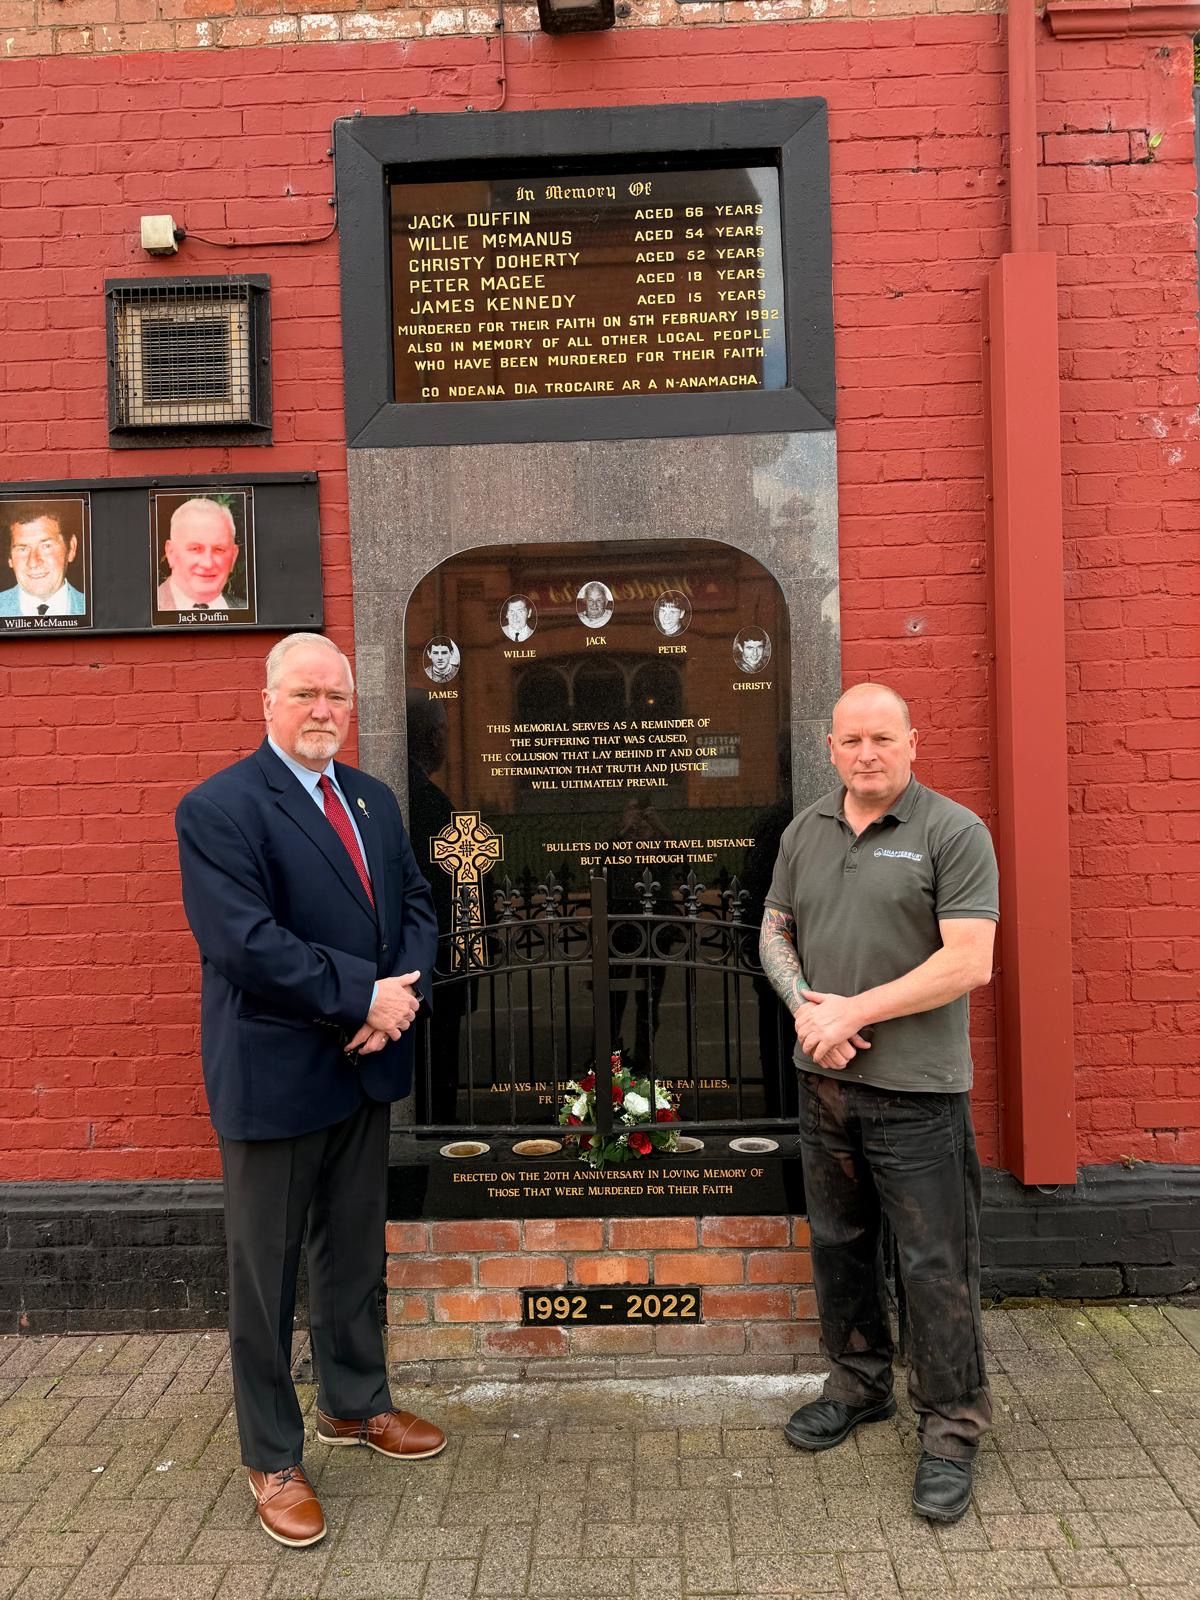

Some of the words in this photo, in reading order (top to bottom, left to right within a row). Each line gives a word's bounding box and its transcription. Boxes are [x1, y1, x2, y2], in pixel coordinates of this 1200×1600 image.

[517, 186, 535, 201] In
[545, 184, 616, 200] Memory
[628, 181, 652, 196] Of
[408, 214, 455, 230] JACK
[467, 211, 531, 227] DUFFIN
[634, 208, 674, 220] AGED
[685, 207, 704, 217] 66
[715, 204, 764, 216] YEARS
[408, 235, 469, 252] WILLIE
[634, 229, 674, 242] AGED
[685, 228, 705, 239] 54
[715, 225, 765, 238] YEARS
[409, 256, 485, 273] CHRISTY
[496, 252, 580, 270] DOHERTY
[635, 251, 675, 263] AGED
[686, 250, 706, 261] 52
[716, 247, 766, 260] YEARS
[409, 278, 470, 294] PETER
[481, 274, 546, 291] MAGEE
[635, 272, 675, 284] AGED
[687, 271, 703, 282] 18
[716, 268, 766, 281] YEARS
[410, 298, 475, 315] JAMES
[487, 294, 576, 312] KENNEDY
[636, 293, 676, 305] AGED
[688, 292, 702, 303] 15
[717, 289, 766, 301] YEARS
[398, 323, 471, 336] MURDERED
[478, 321, 505, 333] FOR
[510, 319, 550, 332] THEIR
[556, 317, 596, 330] FAITH
[603, 315, 621, 328] ON
[629, 314, 654, 327] 5TH
[662, 310, 738, 325] FEBRUARY
[407, 342, 442, 354] ALSO
[450, 341, 464, 352] IN
[472, 338, 533, 351] MEMORY
[542, 337, 560, 349] OF
[567, 336, 593, 348] ALL
[601, 334, 648, 346] OTHER
[657, 331, 705, 345] LOCAL
[713, 328, 772, 342] PEOPLE
[414, 360, 446, 371] WHO
[454, 358, 492, 370] HAVE
[500, 356, 539, 369] BEEN
[548, 353, 628, 367] MURDERED
[636, 351, 665, 363] FOR
[672, 349, 716, 361] THEIR
[723, 347, 768, 359] FAITH.
[421, 387, 440, 398] GO
[449, 385, 505, 397] NDEANA
[514, 383, 538, 395] DIA
[544, 380, 615, 393] TROCAIRE
[622, 379, 641, 390] AR
[648, 378, 658, 389] A
[665, 374, 762, 388] N-ANAMACHA.
[5, 618, 32, 628] Willie
[34, 617, 78, 628] McManus
[178, 612, 198, 624] Jack
[200, 611, 229, 621] Duffin
[586, 636, 607, 646] JACK
[503, 650, 537, 659] WILLIE
[658, 645, 687, 654] PETER
[732, 681, 772, 691] CHRISTY
[428, 690, 459, 700] JAMES
[487, 724, 511, 733] THIS
[514, 723, 569, 732] MEMORIAL
[572, 721, 610, 731] SERVES
[613, 721, 627, 730] AS
[630, 720, 638, 729] A
[641, 719, 695, 729] REMINDER
[697, 718, 711, 727] OF
[510, 738, 531, 747] THE
[534, 737, 590, 747] SUFFERING
[592, 736, 620, 745] THAT
[623, 735, 646, 744] WAS
[648, 734, 688, 744] CAUSED,
[481, 753, 502, 762] THE
[505, 751, 559, 761] COLLUSION
[561, 751, 590, 760] THAT
[592, 750, 612, 759] LAY
[615, 749, 654, 759] BEHIND
[656, 748, 667, 758] IT
[669, 748, 693, 757] AND
[695, 747, 718, 756] OUR
[491, 765, 573, 776] DETERMINATION
[575, 765, 604, 774] THAT
[606, 764, 641, 773] TRUTH
[644, 763, 668, 772] AND
[670, 762, 709, 774] JUSTICE
[531, 781, 558, 790] WILL
[560, 779, 624, 789] ULTIMATELY
[541, 843, 592, 852] "BULLETS
[594, 841, 610, 851] DO
[612, 841, 634, 850] NOT
[635, 840, 662, 850] ONLY
[663, 839, 704, 849] TRAVEL
[706, 838, 756, 848] DISTANCE
[580, 856, 602, 866] BUT
[604, 855, 633, 865] ALSO
[634, 854, 684, 864] THROUGH
[686, 853, 718, 863] TIME"
[535, 1081, 547, 1091] IN
[453, 1173, 498, 1183] ERECTED
[500, 1172, 516, 1181] ON
[518, 1171, 540, 1181] THE
[543, 1171, 570, 1181] 20TH
[573, 1170, 645, 1180] ANNIVERSARY
[648, 1169, 659, 1179] IN
[663, 1169, 700, 1179] LOVING
[703, 1168, 748, 1179] MEMORY
[750, 1167, 764, 1178] OF
[487, 1187, 521, 1197] THOSE
[523, 1187, 552, 1196] THAT
[554, 1186, 585, 1196] WERE
[588, 1185, 644, 1196] MURDERED
[647, 1185, 665, 1195] FOR
[667, 1184, 700, 1195] THEIR
[702, 1184, 734, 1195] FAITH
[528, 1296, 588, 1320] 1992
[626, 1293, 697, 1318] 2022
